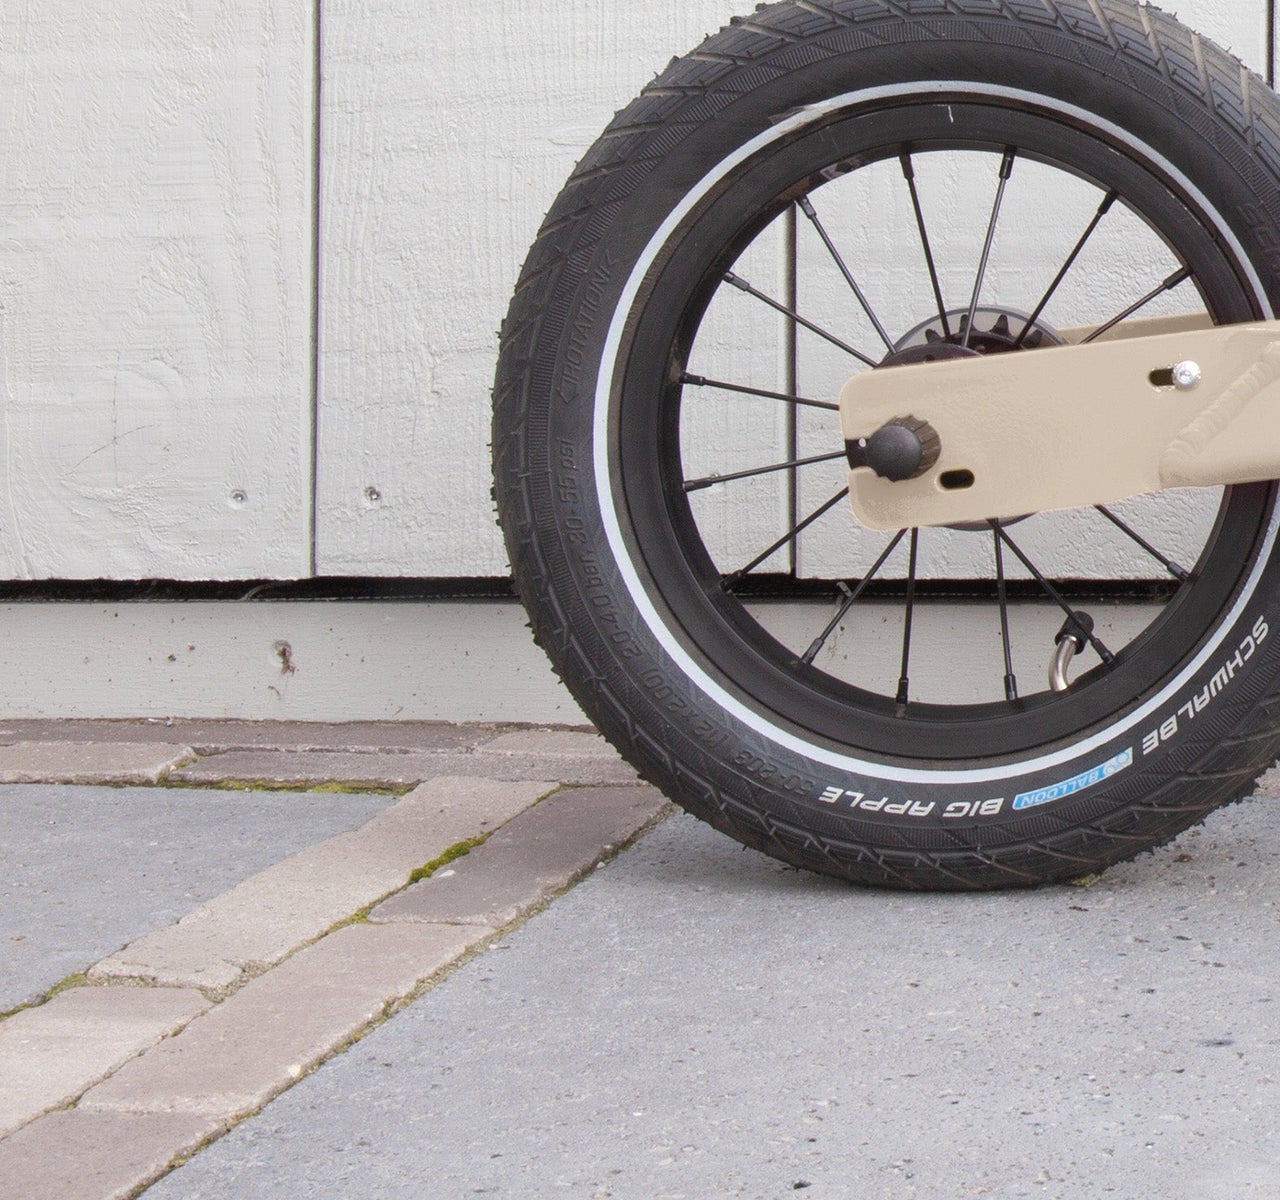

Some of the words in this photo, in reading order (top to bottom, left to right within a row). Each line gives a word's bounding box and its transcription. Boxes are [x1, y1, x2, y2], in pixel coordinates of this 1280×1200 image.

[1143, 615, 1269, 756] SCHWALBE
[819, 785, 935, 817] APPLE
[1020, 771, 1099, 807] BALLOON
[942, 797, 1004, 818] BIG
